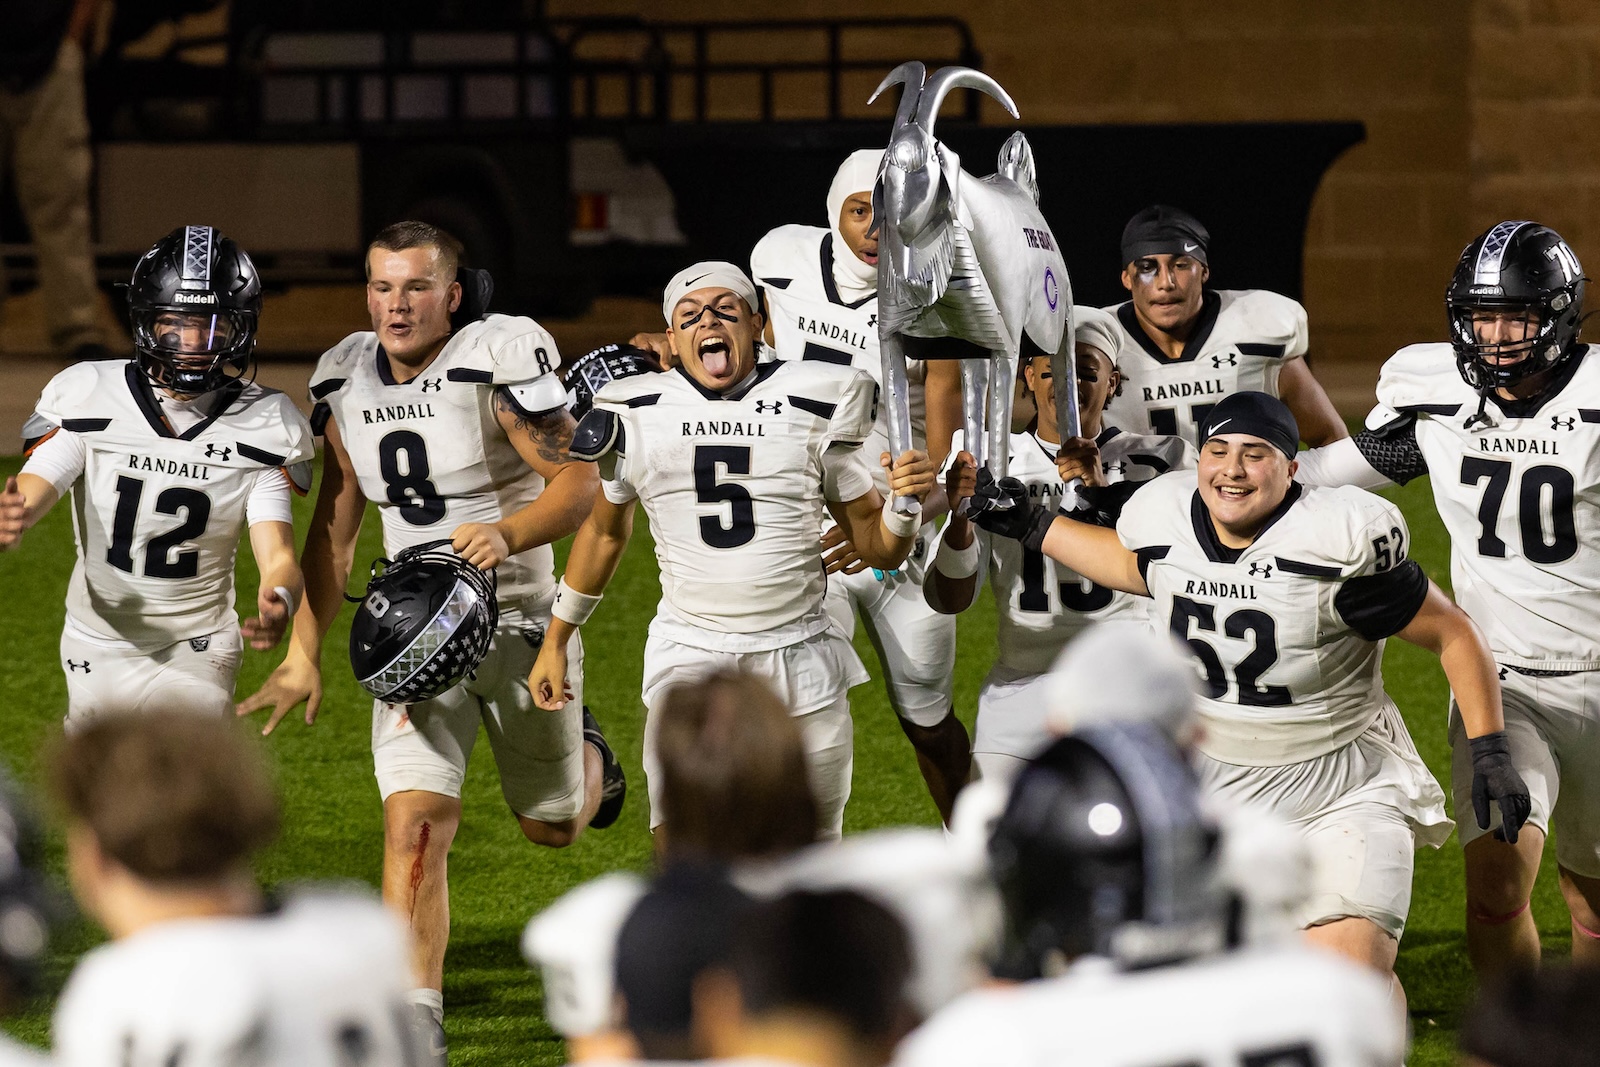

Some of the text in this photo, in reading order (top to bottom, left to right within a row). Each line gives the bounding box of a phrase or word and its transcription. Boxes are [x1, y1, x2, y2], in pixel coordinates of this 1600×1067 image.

[1545, 241, 1581, 283] 70
[174, 293, 215, 305] Riddell
[798, 316, 867, 350] RANDALL
[534, 347, 553, 376] 8
[1142, 379, 1225, 402] RANDALL
[362, 403, 436, 425] RANDALL
[681, 421, 767, 437] RANDALL
[1479, 437, 1560, 456] RANDALL
[128, 454, 210, 481] RANDALL
[377, 429, 448, 526] 8
[692, 443, 758, 550] 5
[1459, 455, 1580, 565] 70
[105, 474, 213, 580] 12
[1372, 526, 1405, 572] 52
[366, 590, 391, 619] 8
[1185, 580, 1258, 600] RANDALL
[1170, 594, 1293, 706] 52
